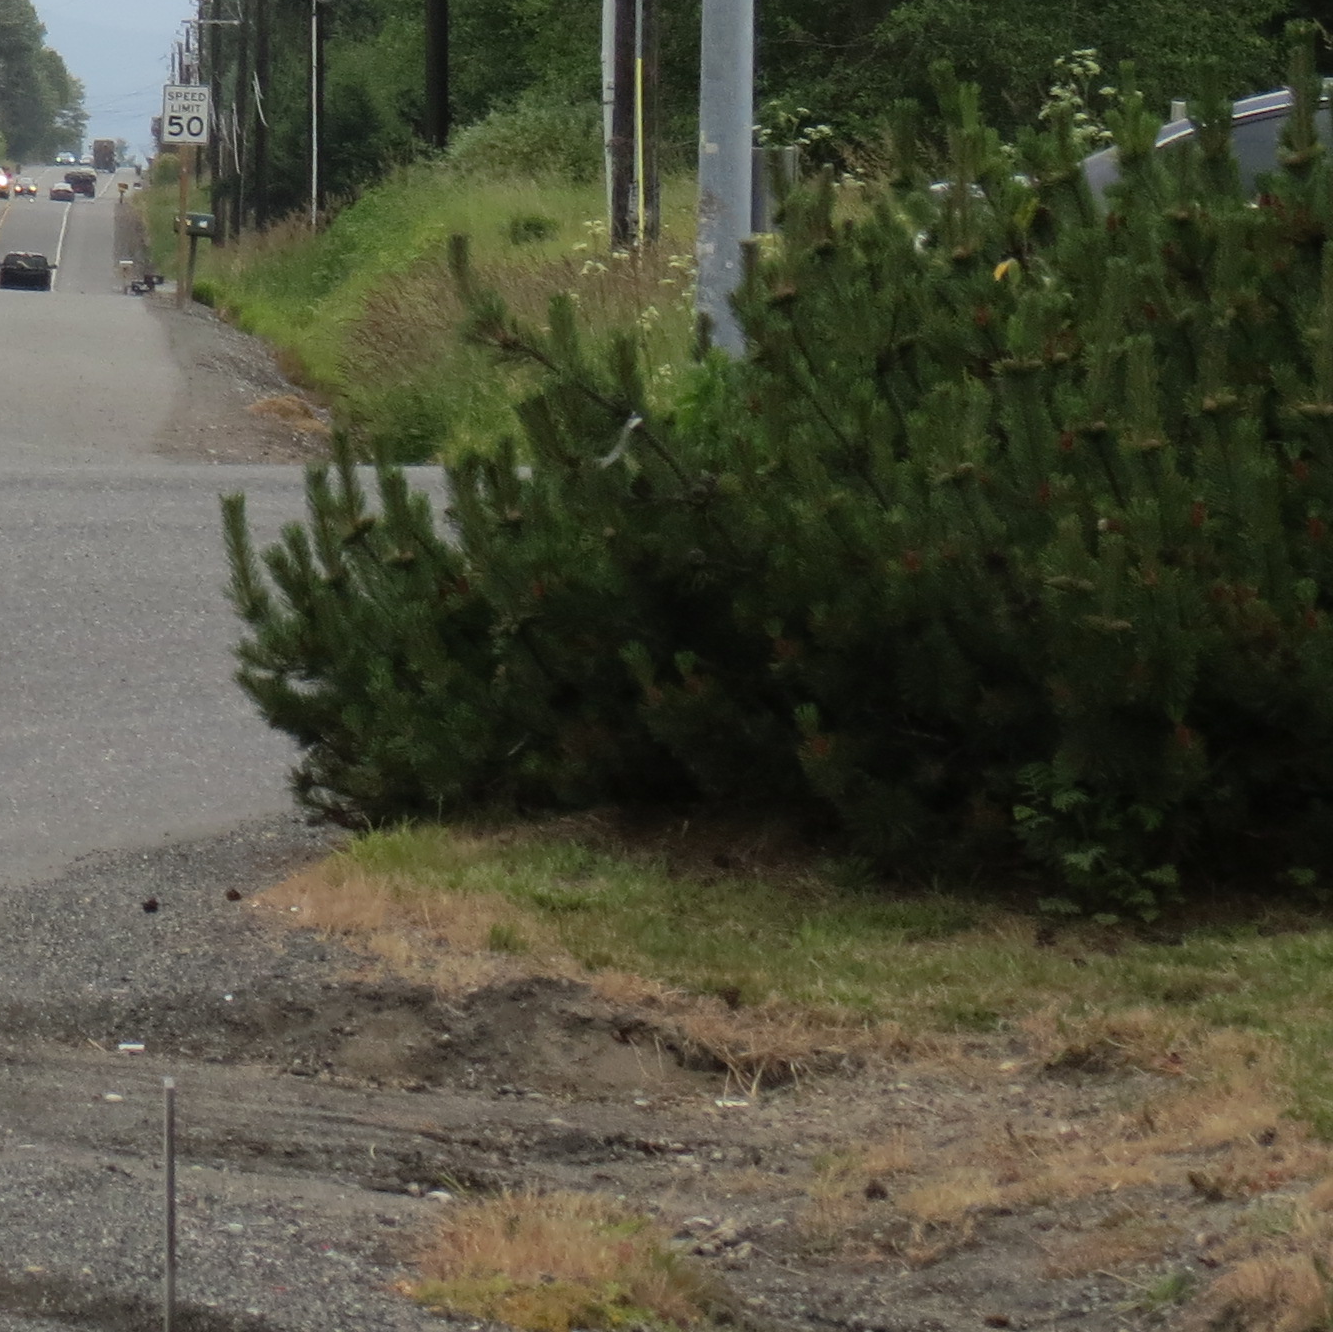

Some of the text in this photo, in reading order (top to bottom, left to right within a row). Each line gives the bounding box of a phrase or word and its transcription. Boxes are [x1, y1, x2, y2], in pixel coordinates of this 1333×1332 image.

[167, 91, 206, 102] SPEED
[170, 104, 201, 113] LIMIT
[168, 115, 204, 137] 50
